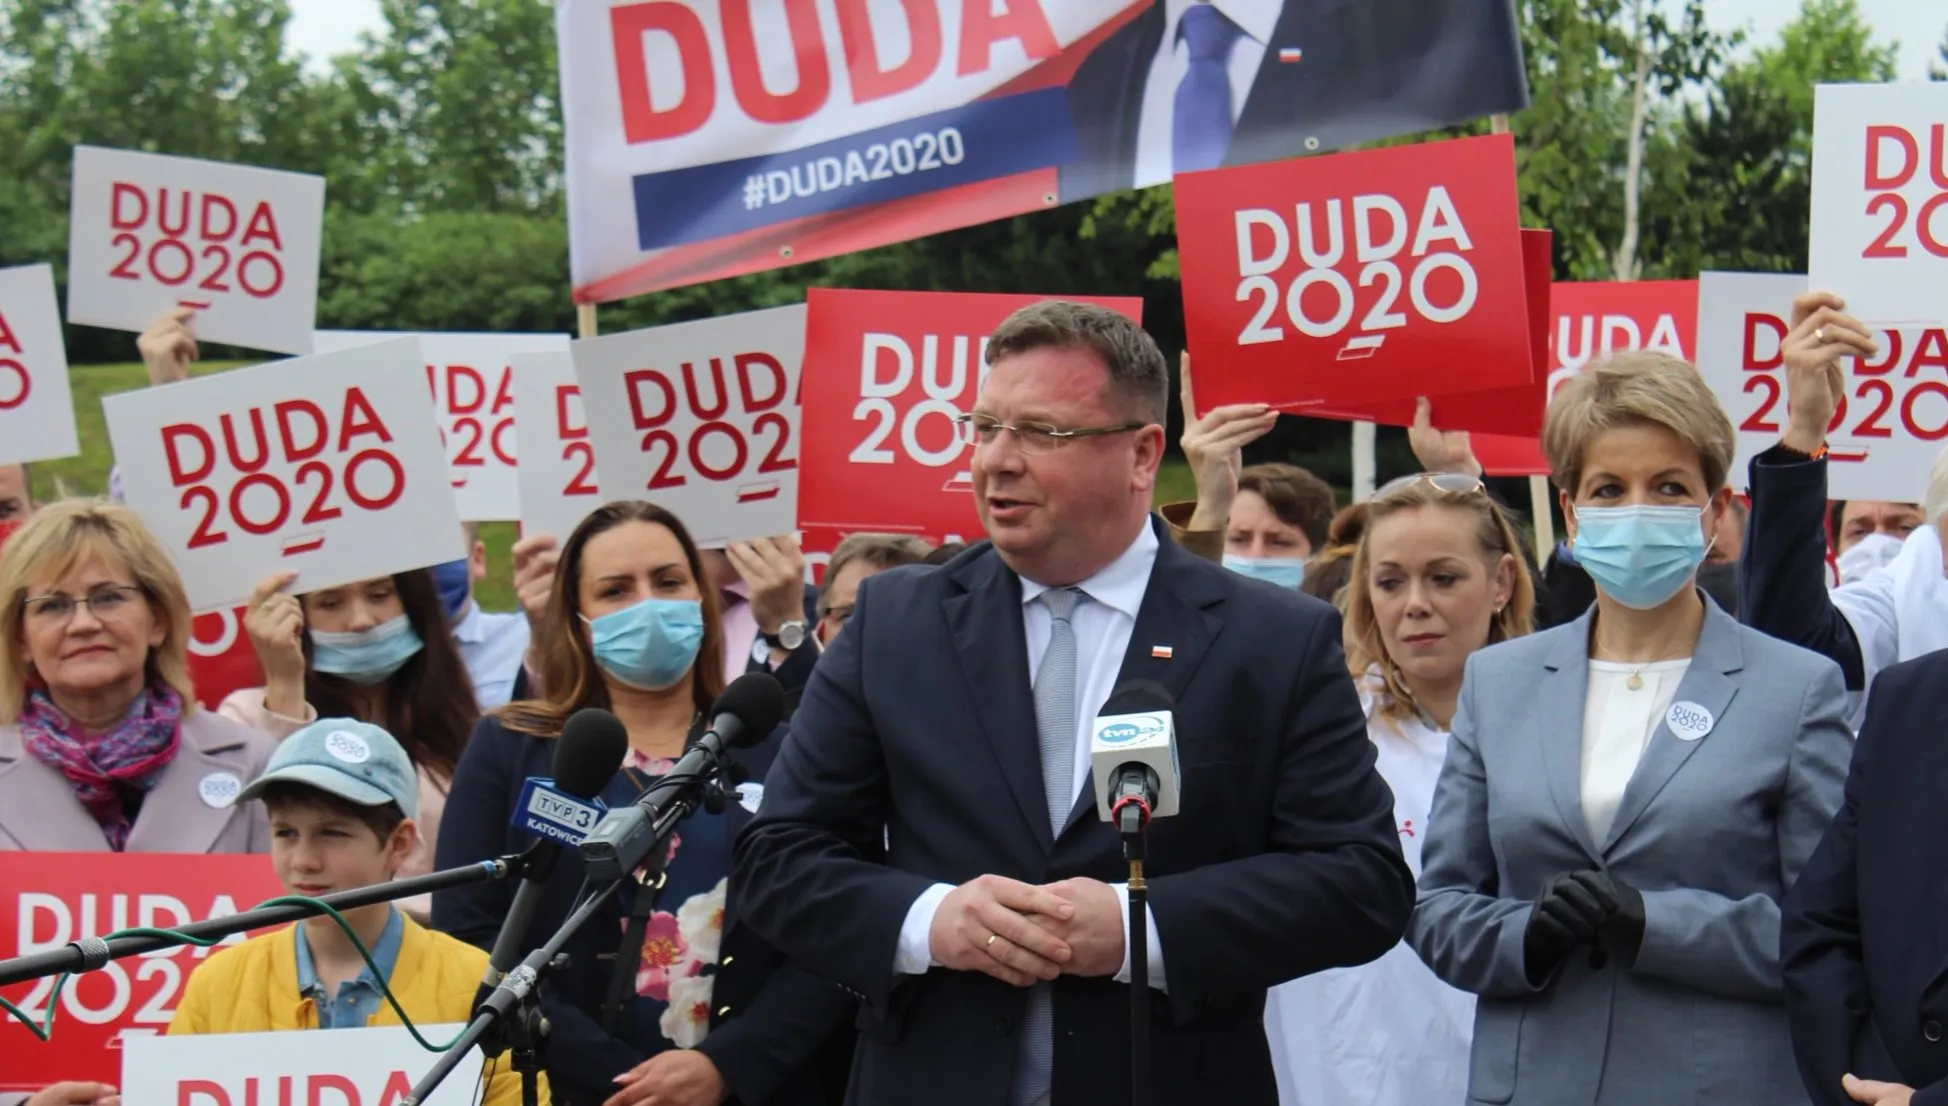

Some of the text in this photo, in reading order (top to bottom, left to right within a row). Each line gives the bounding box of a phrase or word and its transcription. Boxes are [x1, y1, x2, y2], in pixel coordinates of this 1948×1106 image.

[743, 127, 965, 210] #DUDA2020
[110, 182, 284, 251] DUDA
[1234, 185, 1474, 278] DUDA
[108, 233, 285, 298] 2020
[1235, 252, 1478, 345] 2020
[860, 333, 991, 400] DU
[1548, 313, 1687, 368] UDA
[1742, 312, 1948, 378] DDA
[624, 352, 803, 430] DUD
[1739, 374, 1948, 441] 220
[161, 387, 392, 487] DUDA
[641, 412, 798, 490] 202
[848, 397, 975, 466] 20
[180, 449, 405, 549] 2020
[1103, 728, 1136, 738] tvn
[1674, 705, 1708, 724] DUDA
[540, 797, 592, 828] TVP 3
